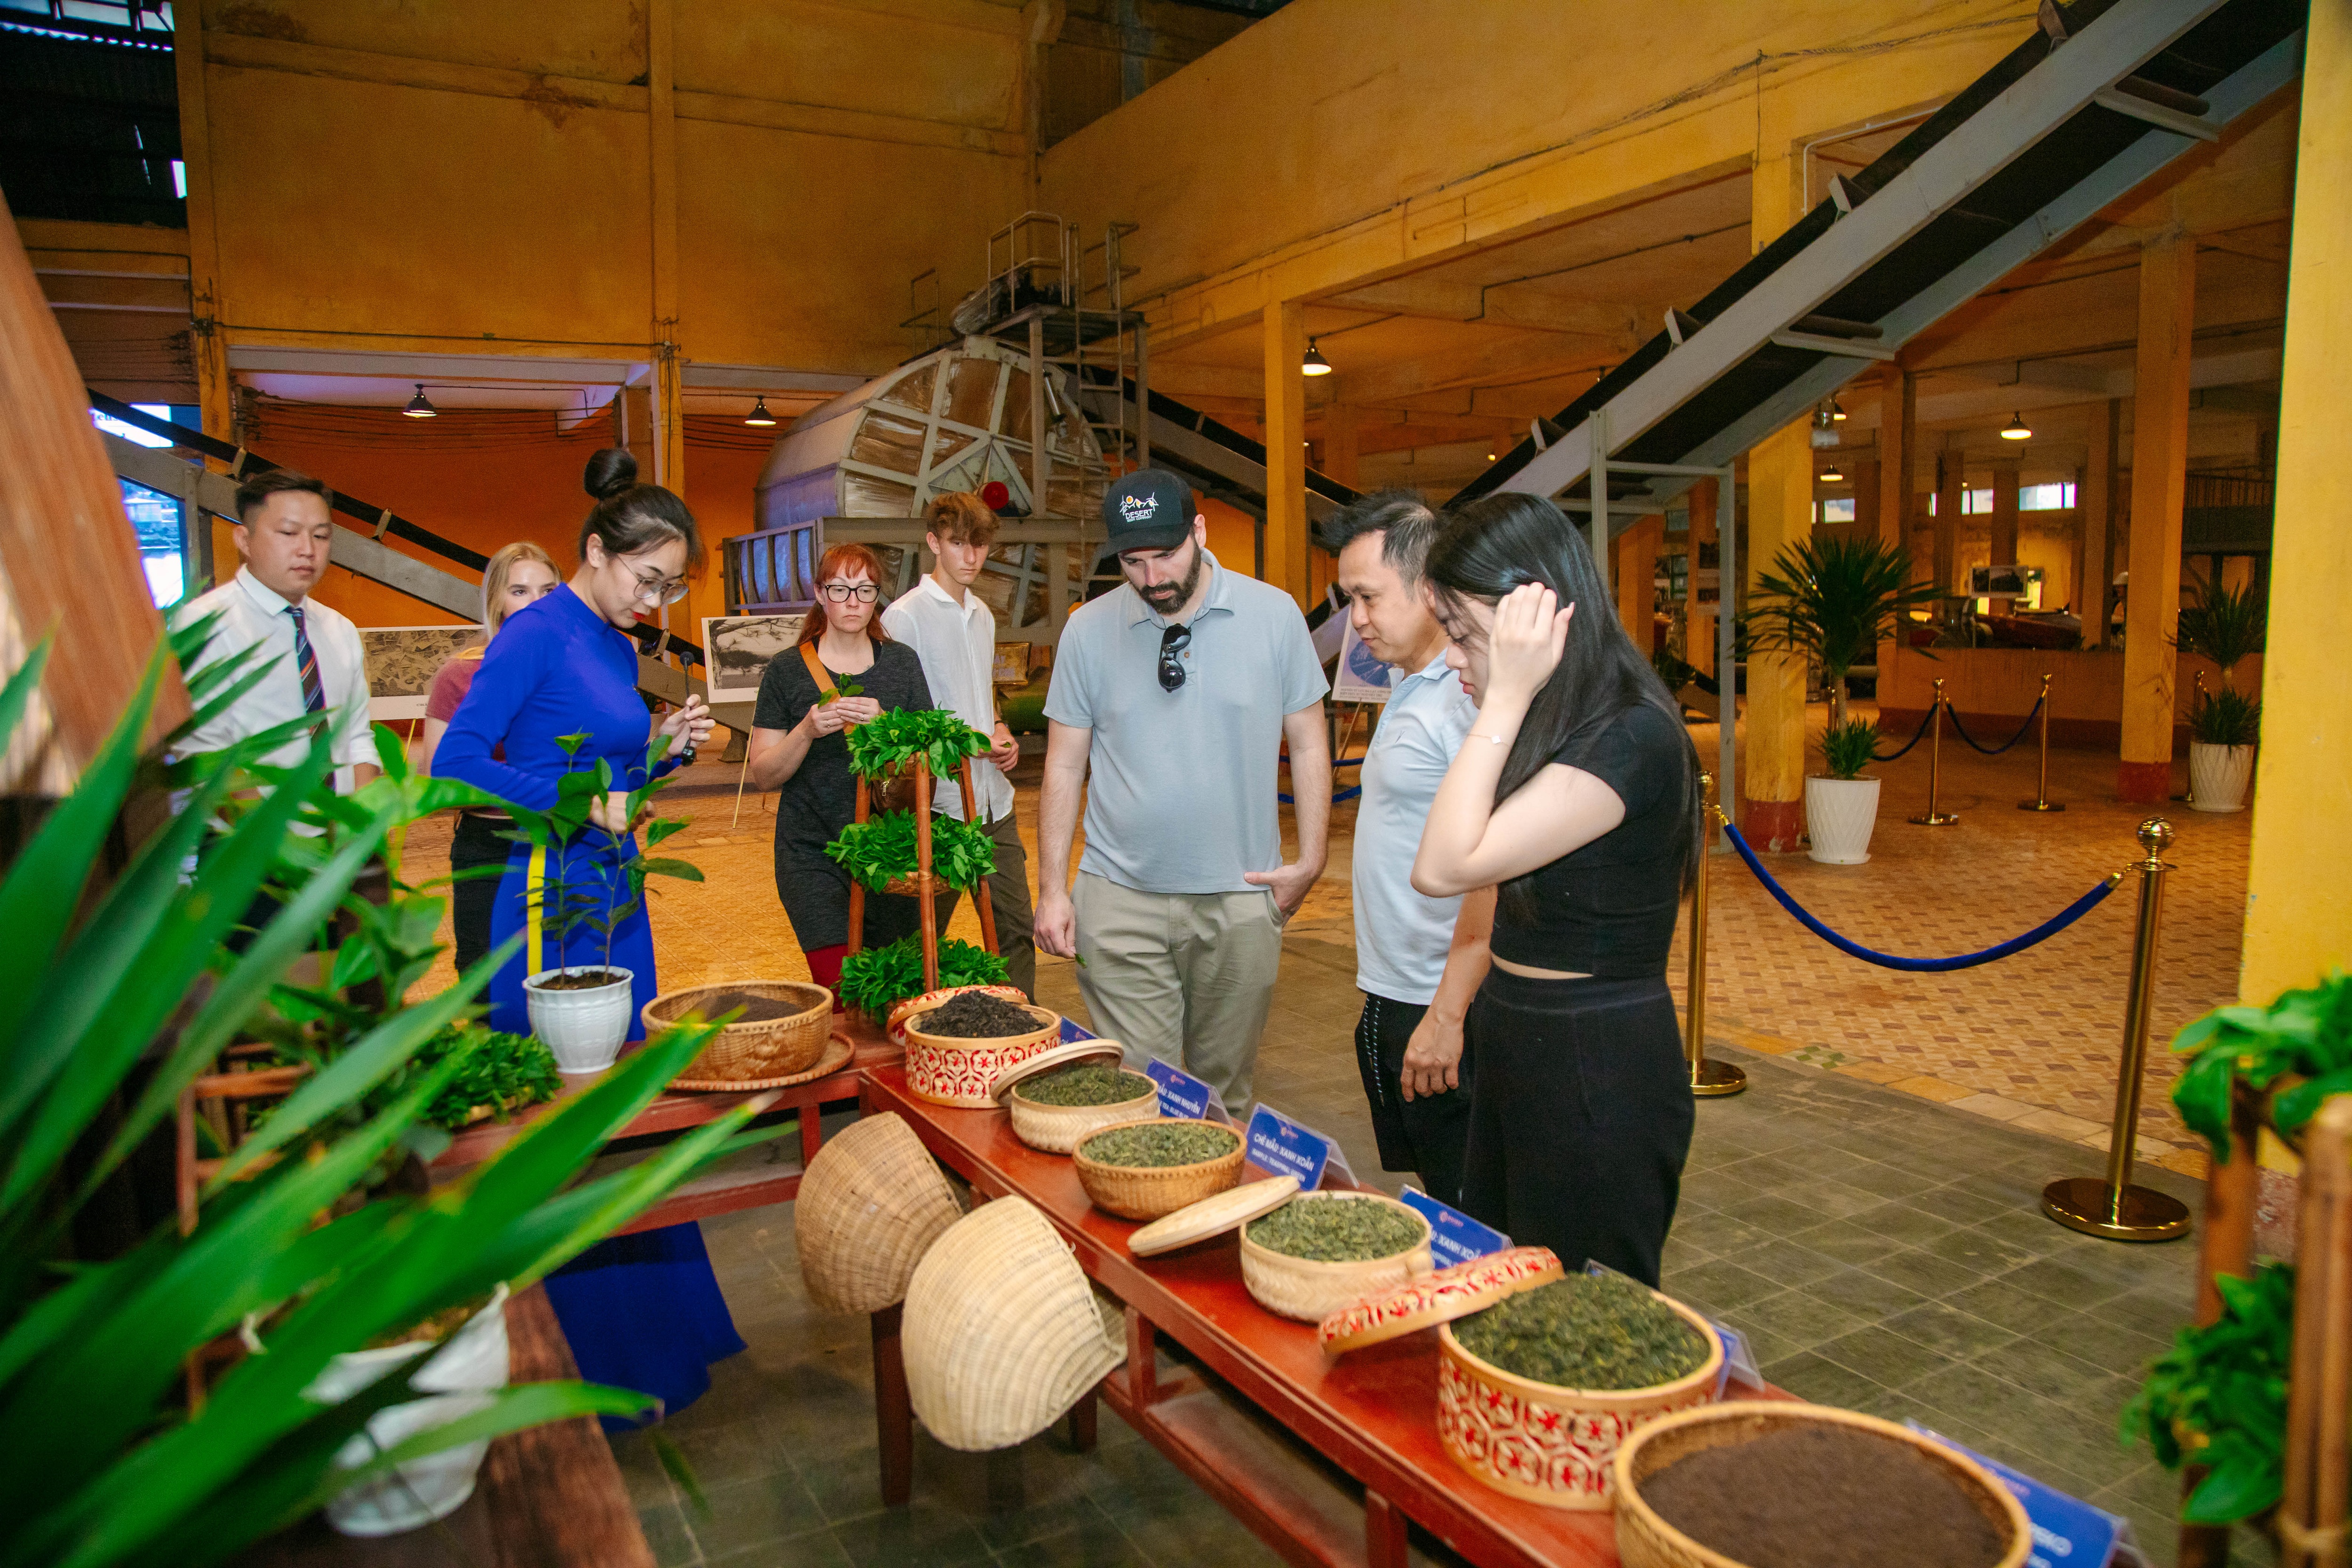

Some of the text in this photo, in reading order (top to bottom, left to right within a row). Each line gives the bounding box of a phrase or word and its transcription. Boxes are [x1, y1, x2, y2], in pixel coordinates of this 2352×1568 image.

[1125, 509, 1153, 519] DESERT
[1168, 1091, 1182, 1105] XANH
[1279, 1146, 1297, 1162] XANH
[1438, 1232, 1462, 1254] XANH
